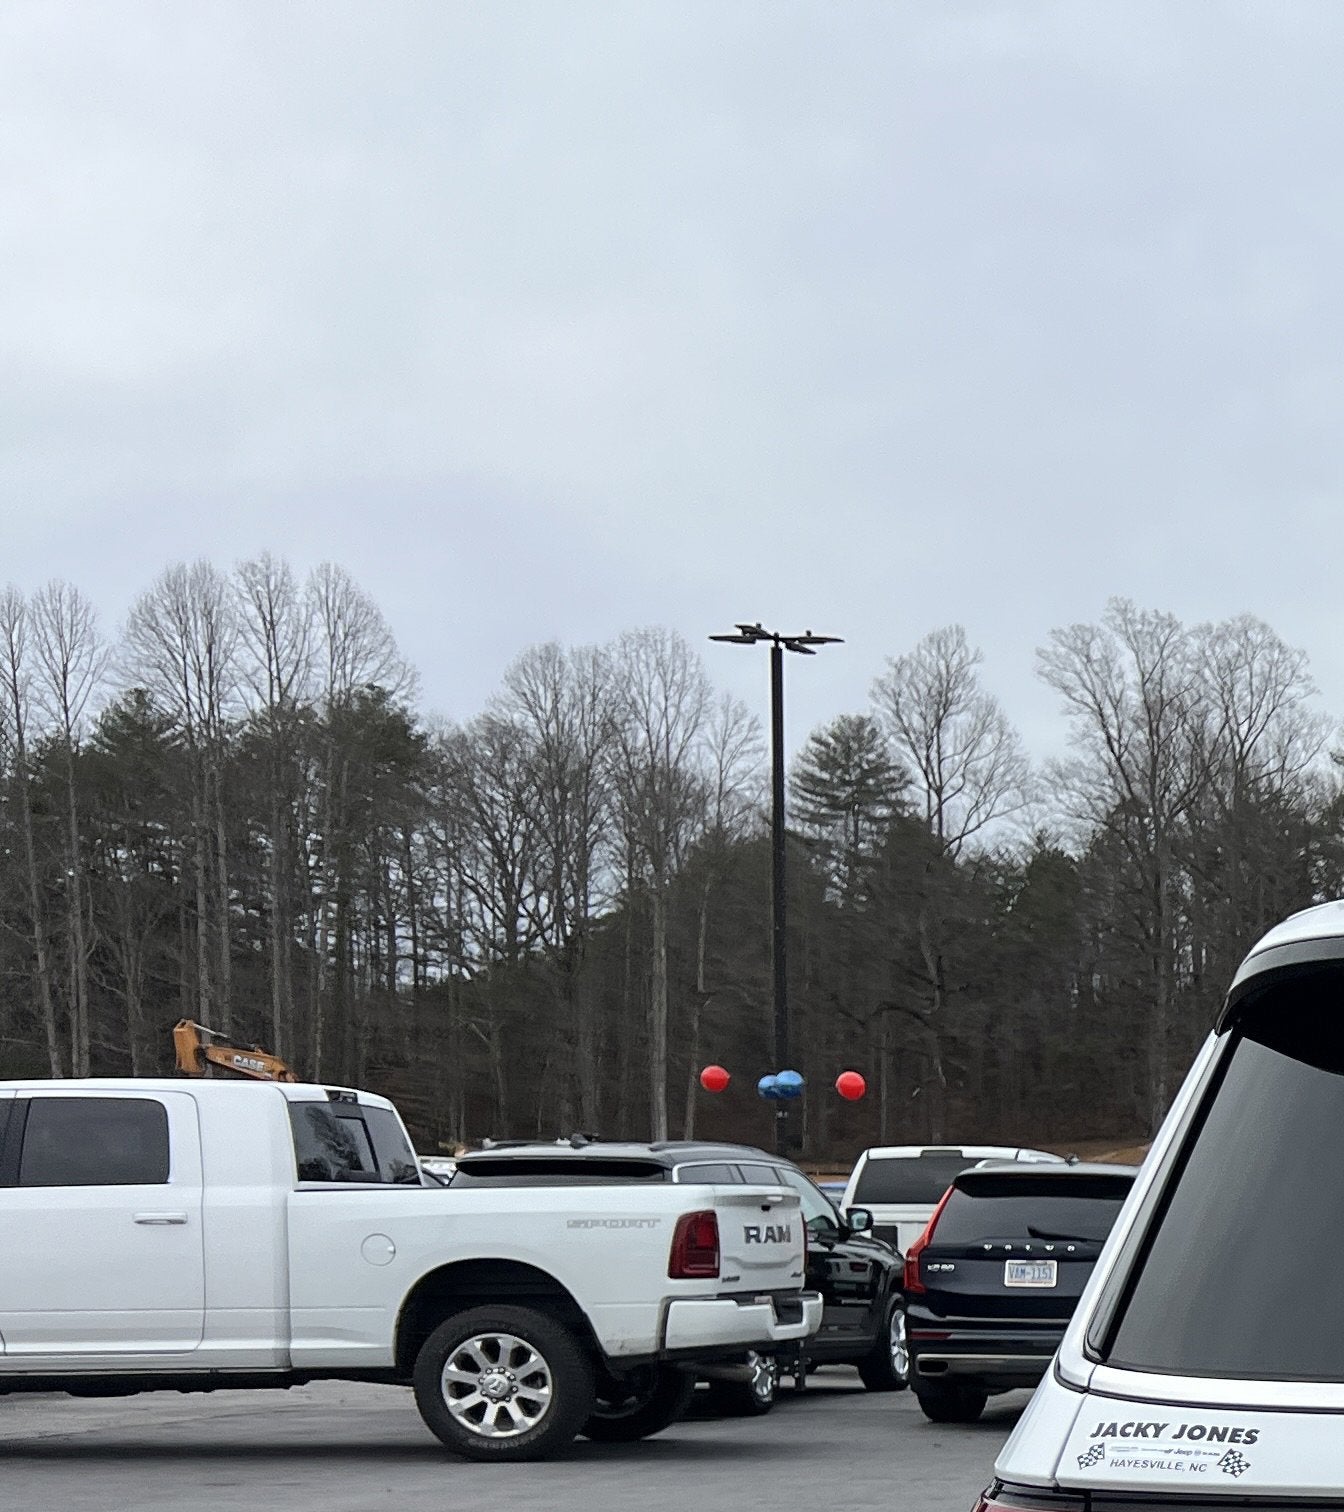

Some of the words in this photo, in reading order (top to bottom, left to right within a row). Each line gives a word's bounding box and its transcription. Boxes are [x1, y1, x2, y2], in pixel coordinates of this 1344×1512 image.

[743, 1225, 792, 1244] RAM
[1090, 1422, 1169, 1438] JACKY
[1171, 1424, 1261, 1445] JONES
[1110, 1459, 1186, 1473] HAYESVILLE,
[1189, 1463, 1208, 1473] NC
